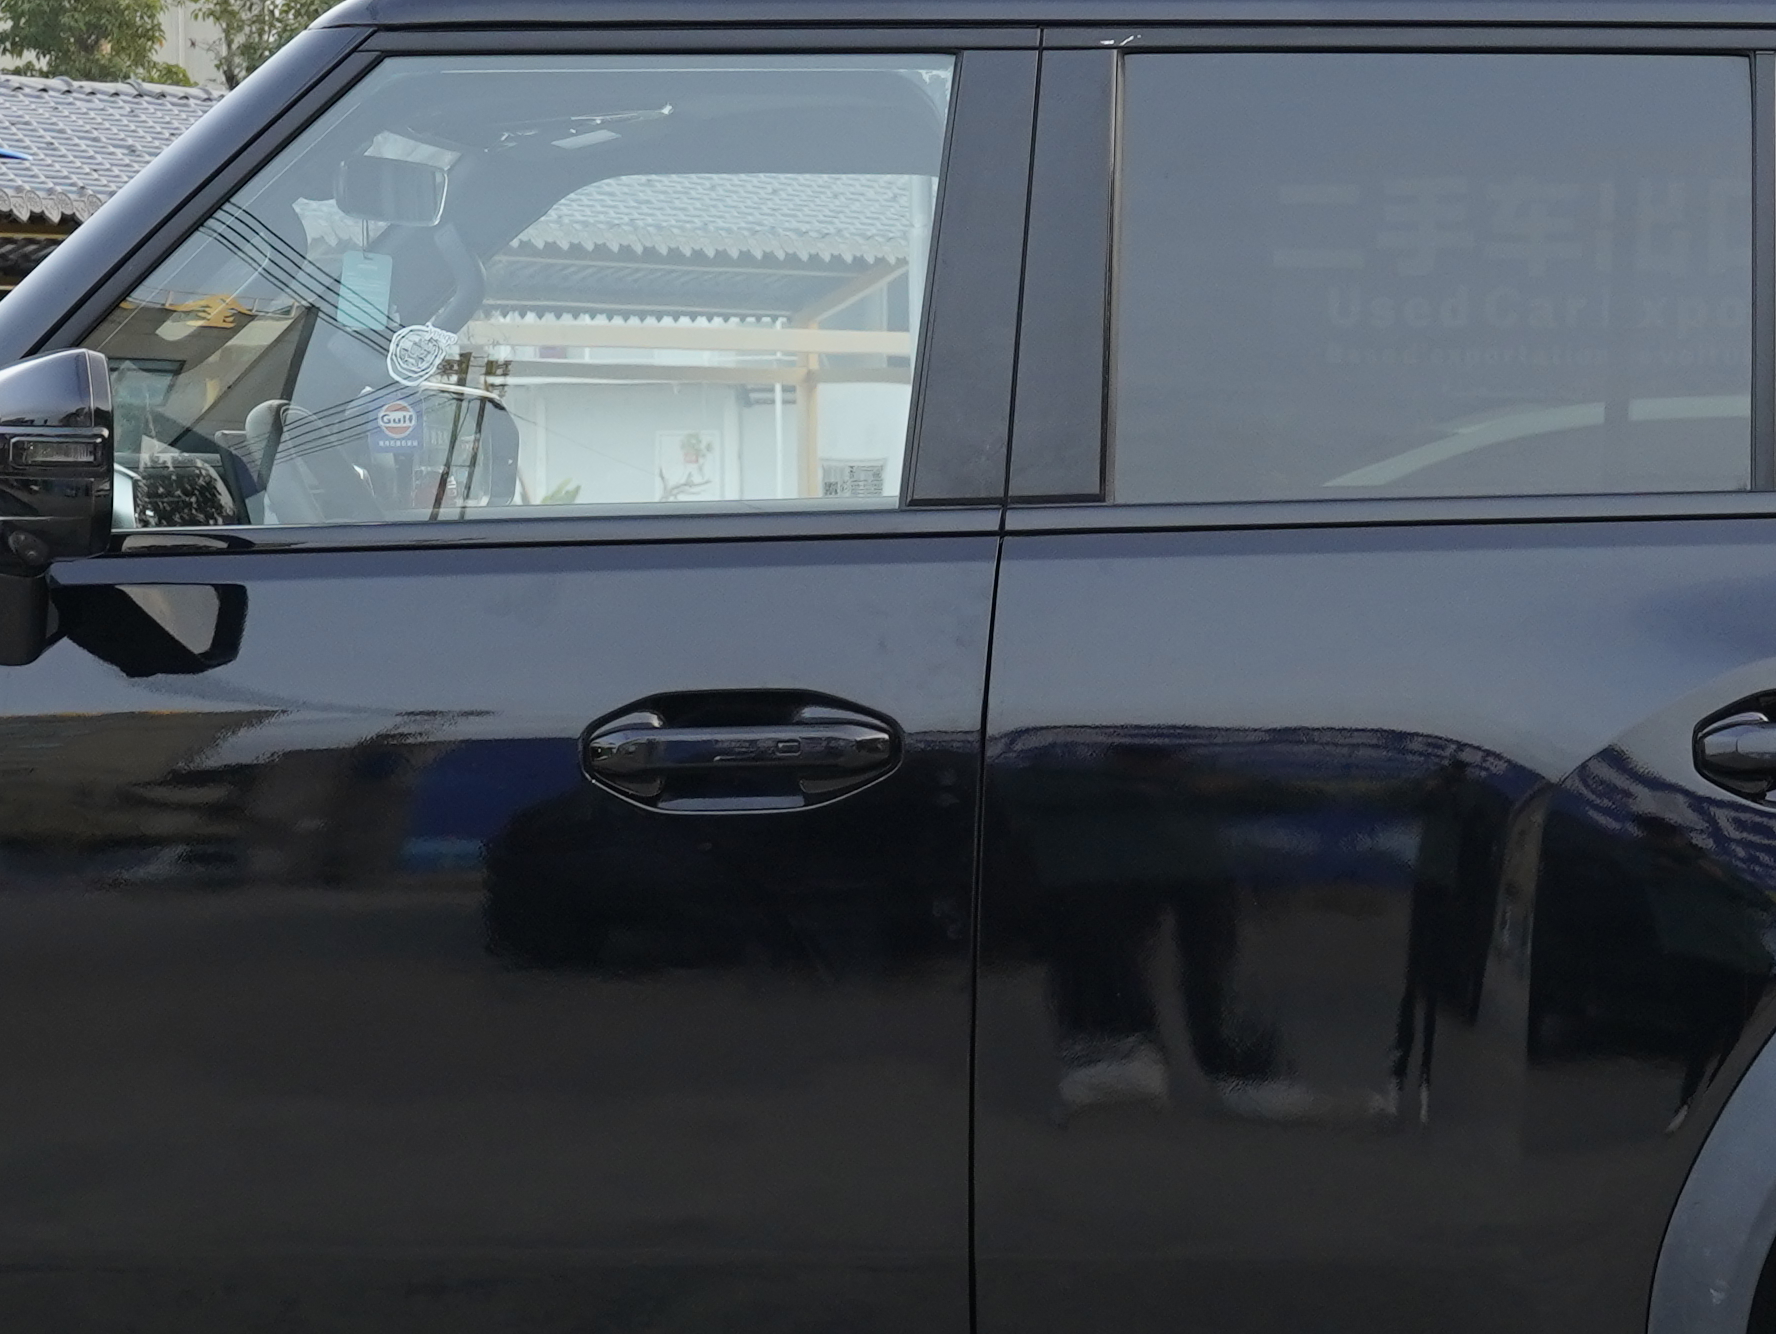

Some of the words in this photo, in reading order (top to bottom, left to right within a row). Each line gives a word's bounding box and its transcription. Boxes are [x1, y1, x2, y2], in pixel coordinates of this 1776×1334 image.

[1327, 282, 1470, 329] Used
[1484, 285, 1588, 329] Car
[381, 413, 413, 424] Gulf
